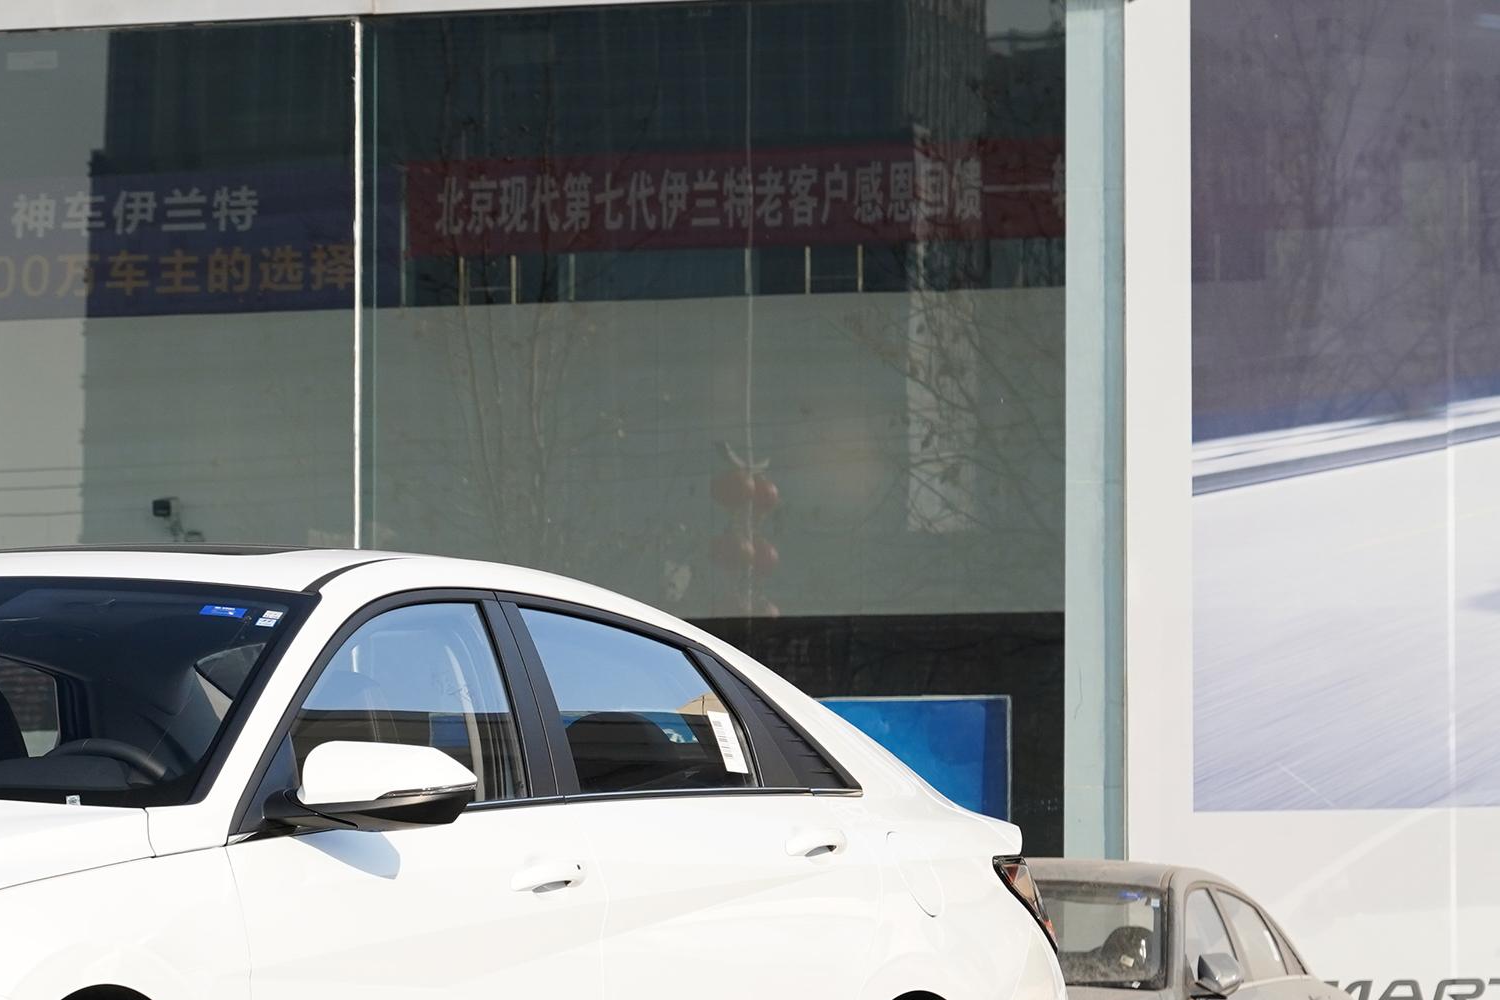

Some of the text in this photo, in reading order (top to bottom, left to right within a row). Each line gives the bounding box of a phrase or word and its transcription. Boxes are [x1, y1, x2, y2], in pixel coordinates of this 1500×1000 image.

[11, 186, 259, 239] 神车伊兰特
